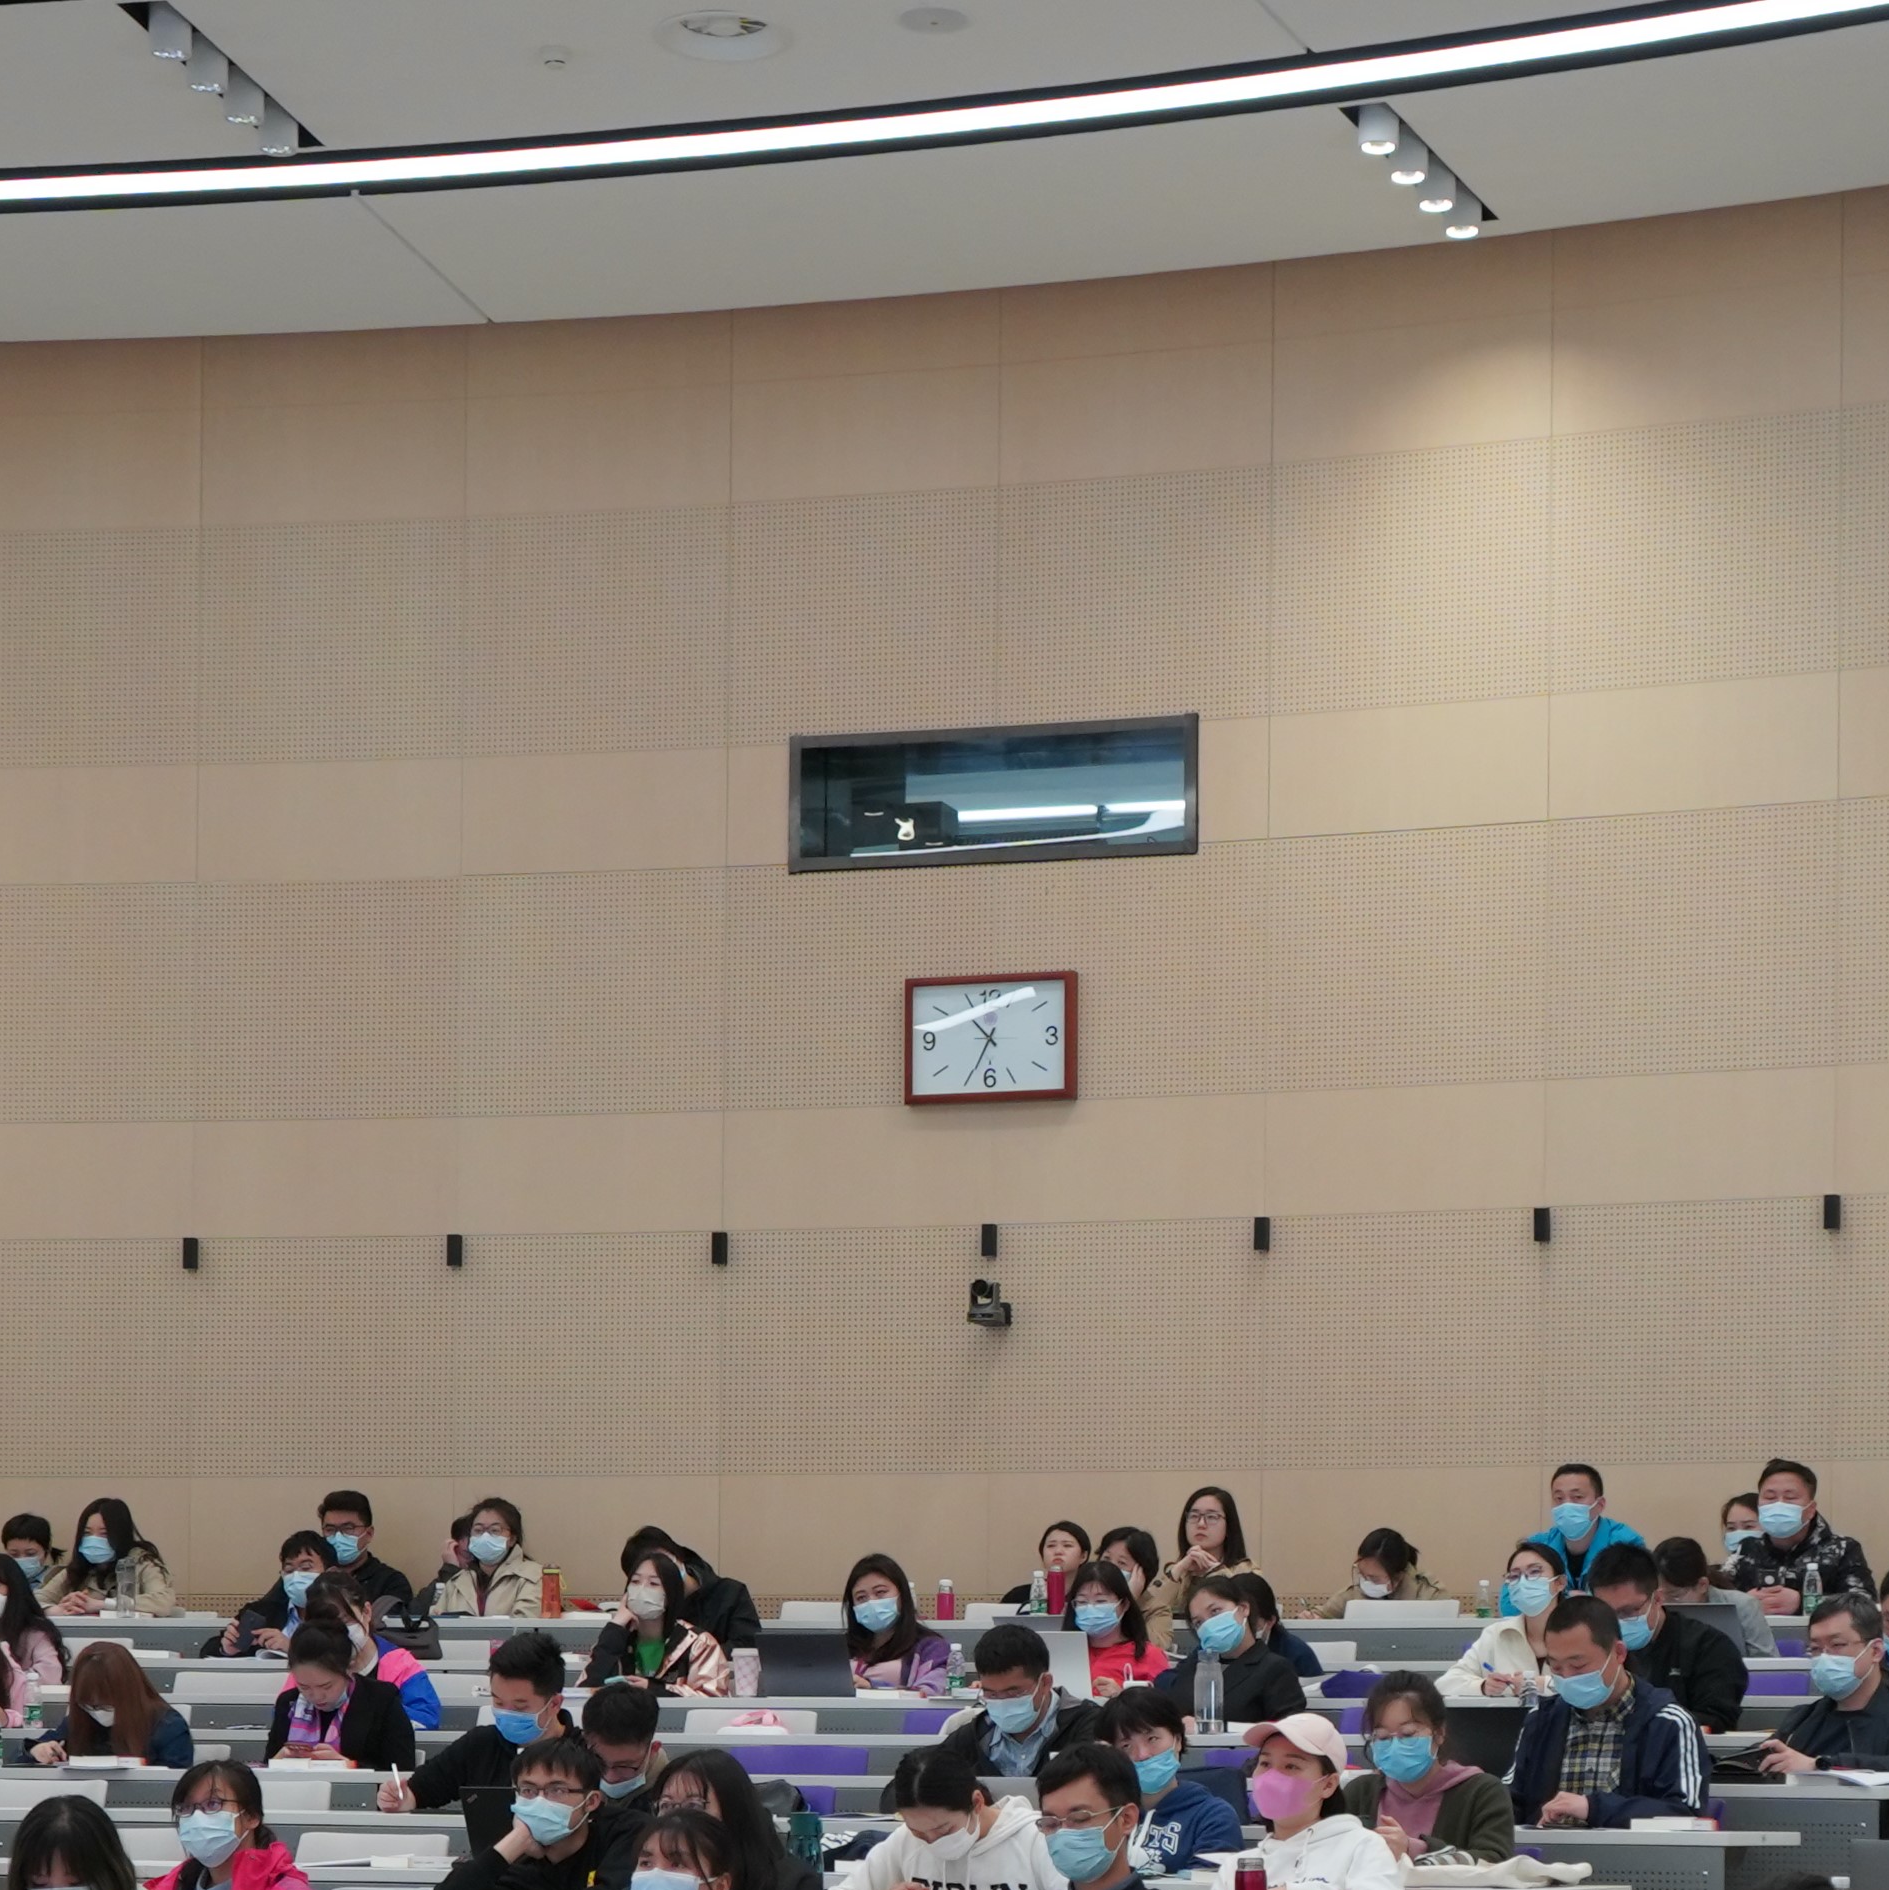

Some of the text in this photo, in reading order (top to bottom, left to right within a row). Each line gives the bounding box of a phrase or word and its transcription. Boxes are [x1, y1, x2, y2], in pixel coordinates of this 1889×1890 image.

[922, 1031, 936, 1051] 9
[1045, 1025, 1058, 1046] 3
[983, 1067, 997, 1088] 6
